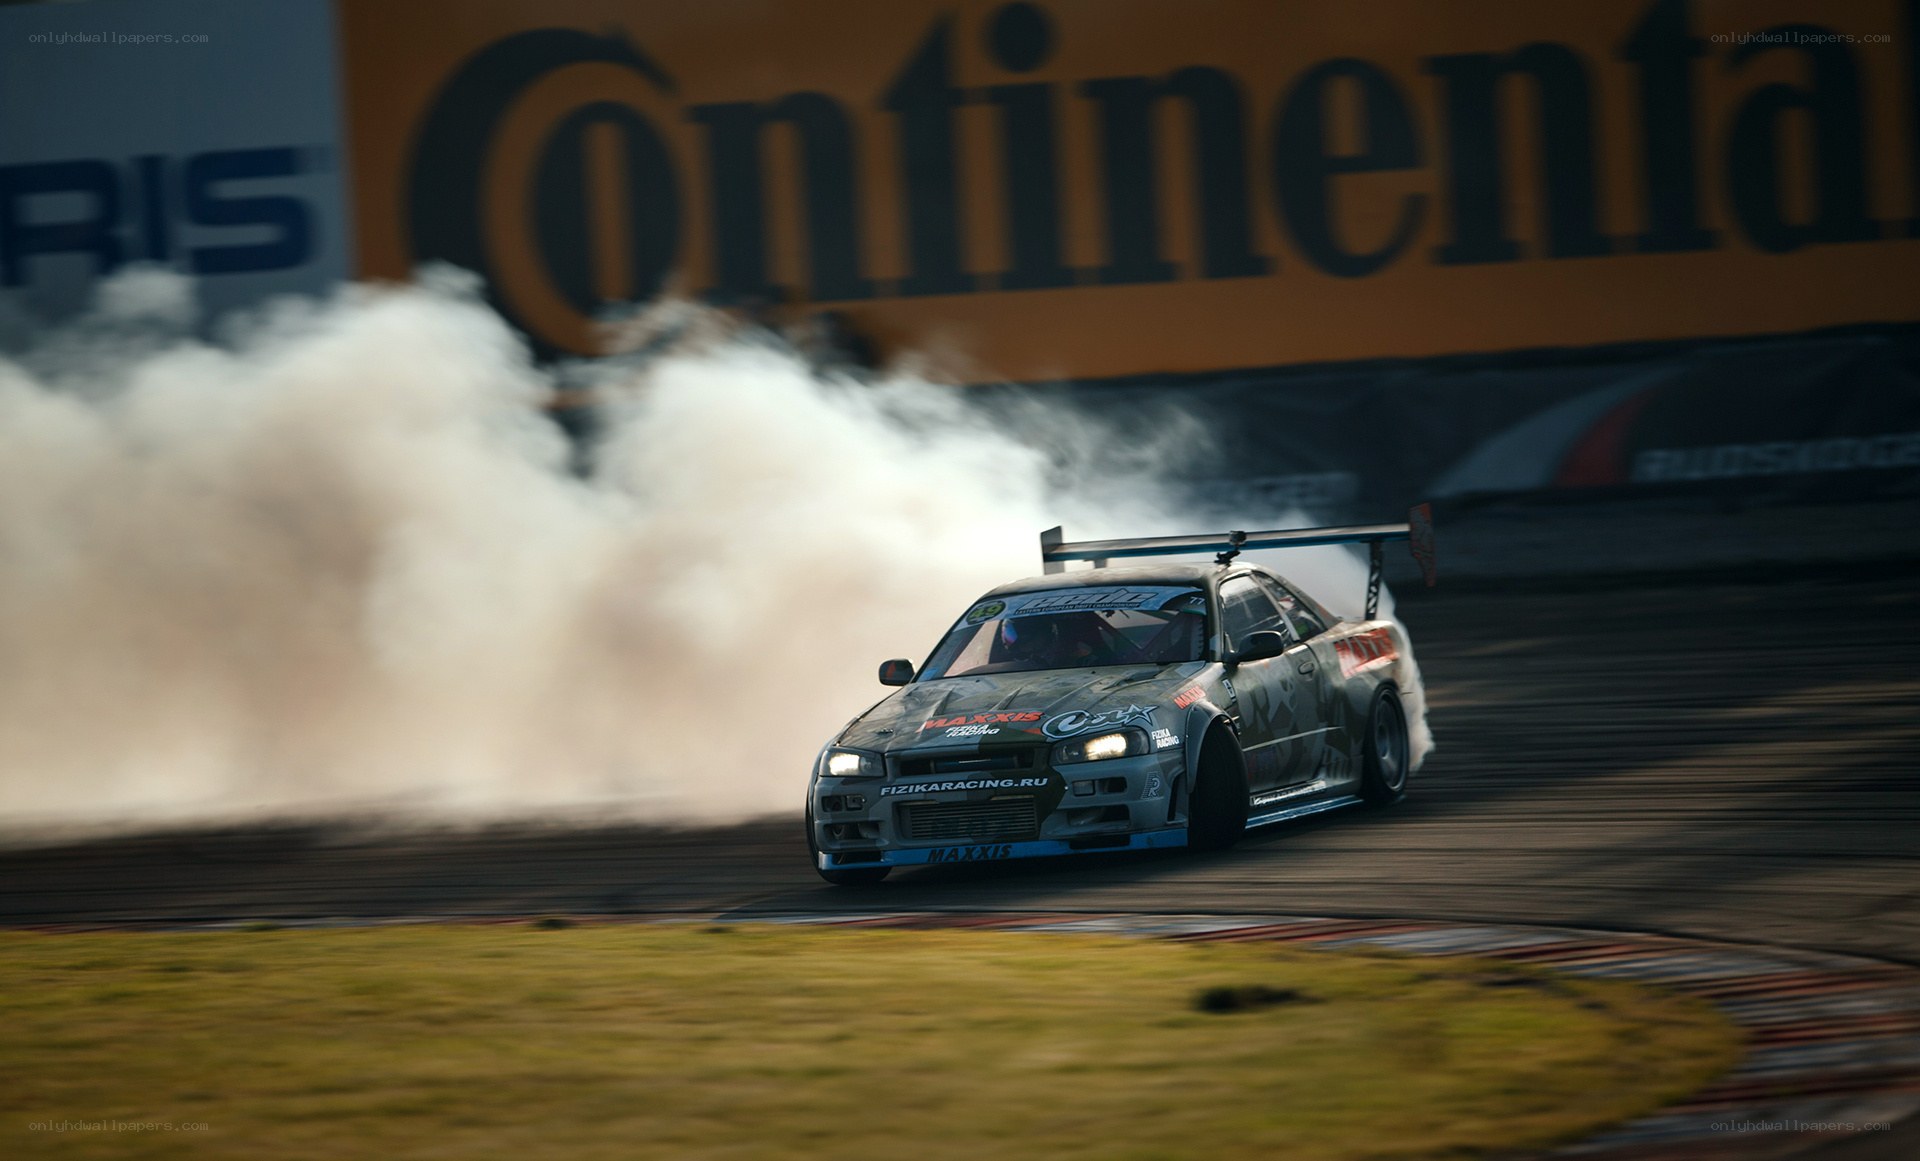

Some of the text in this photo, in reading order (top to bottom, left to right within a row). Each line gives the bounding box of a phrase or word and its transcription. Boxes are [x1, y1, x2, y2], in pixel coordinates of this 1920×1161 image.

[1015, 606, 1042, 615] EASTERN
[1043, 604, 1074, 612] EUROPEAN
[919, 711, 1045, 732] MAXXIS
[945, 724, 989, 733] FIZIKA
[946, 728, 1000, 738] RACING
[1151, 727, 1171, 740] FIZIKA
[1156, 735, 1180, 749] RACING
[880, 776, 1049, 797] FIZIKARACING.RU
[927, 845, 1013, 864] MAXXIS
